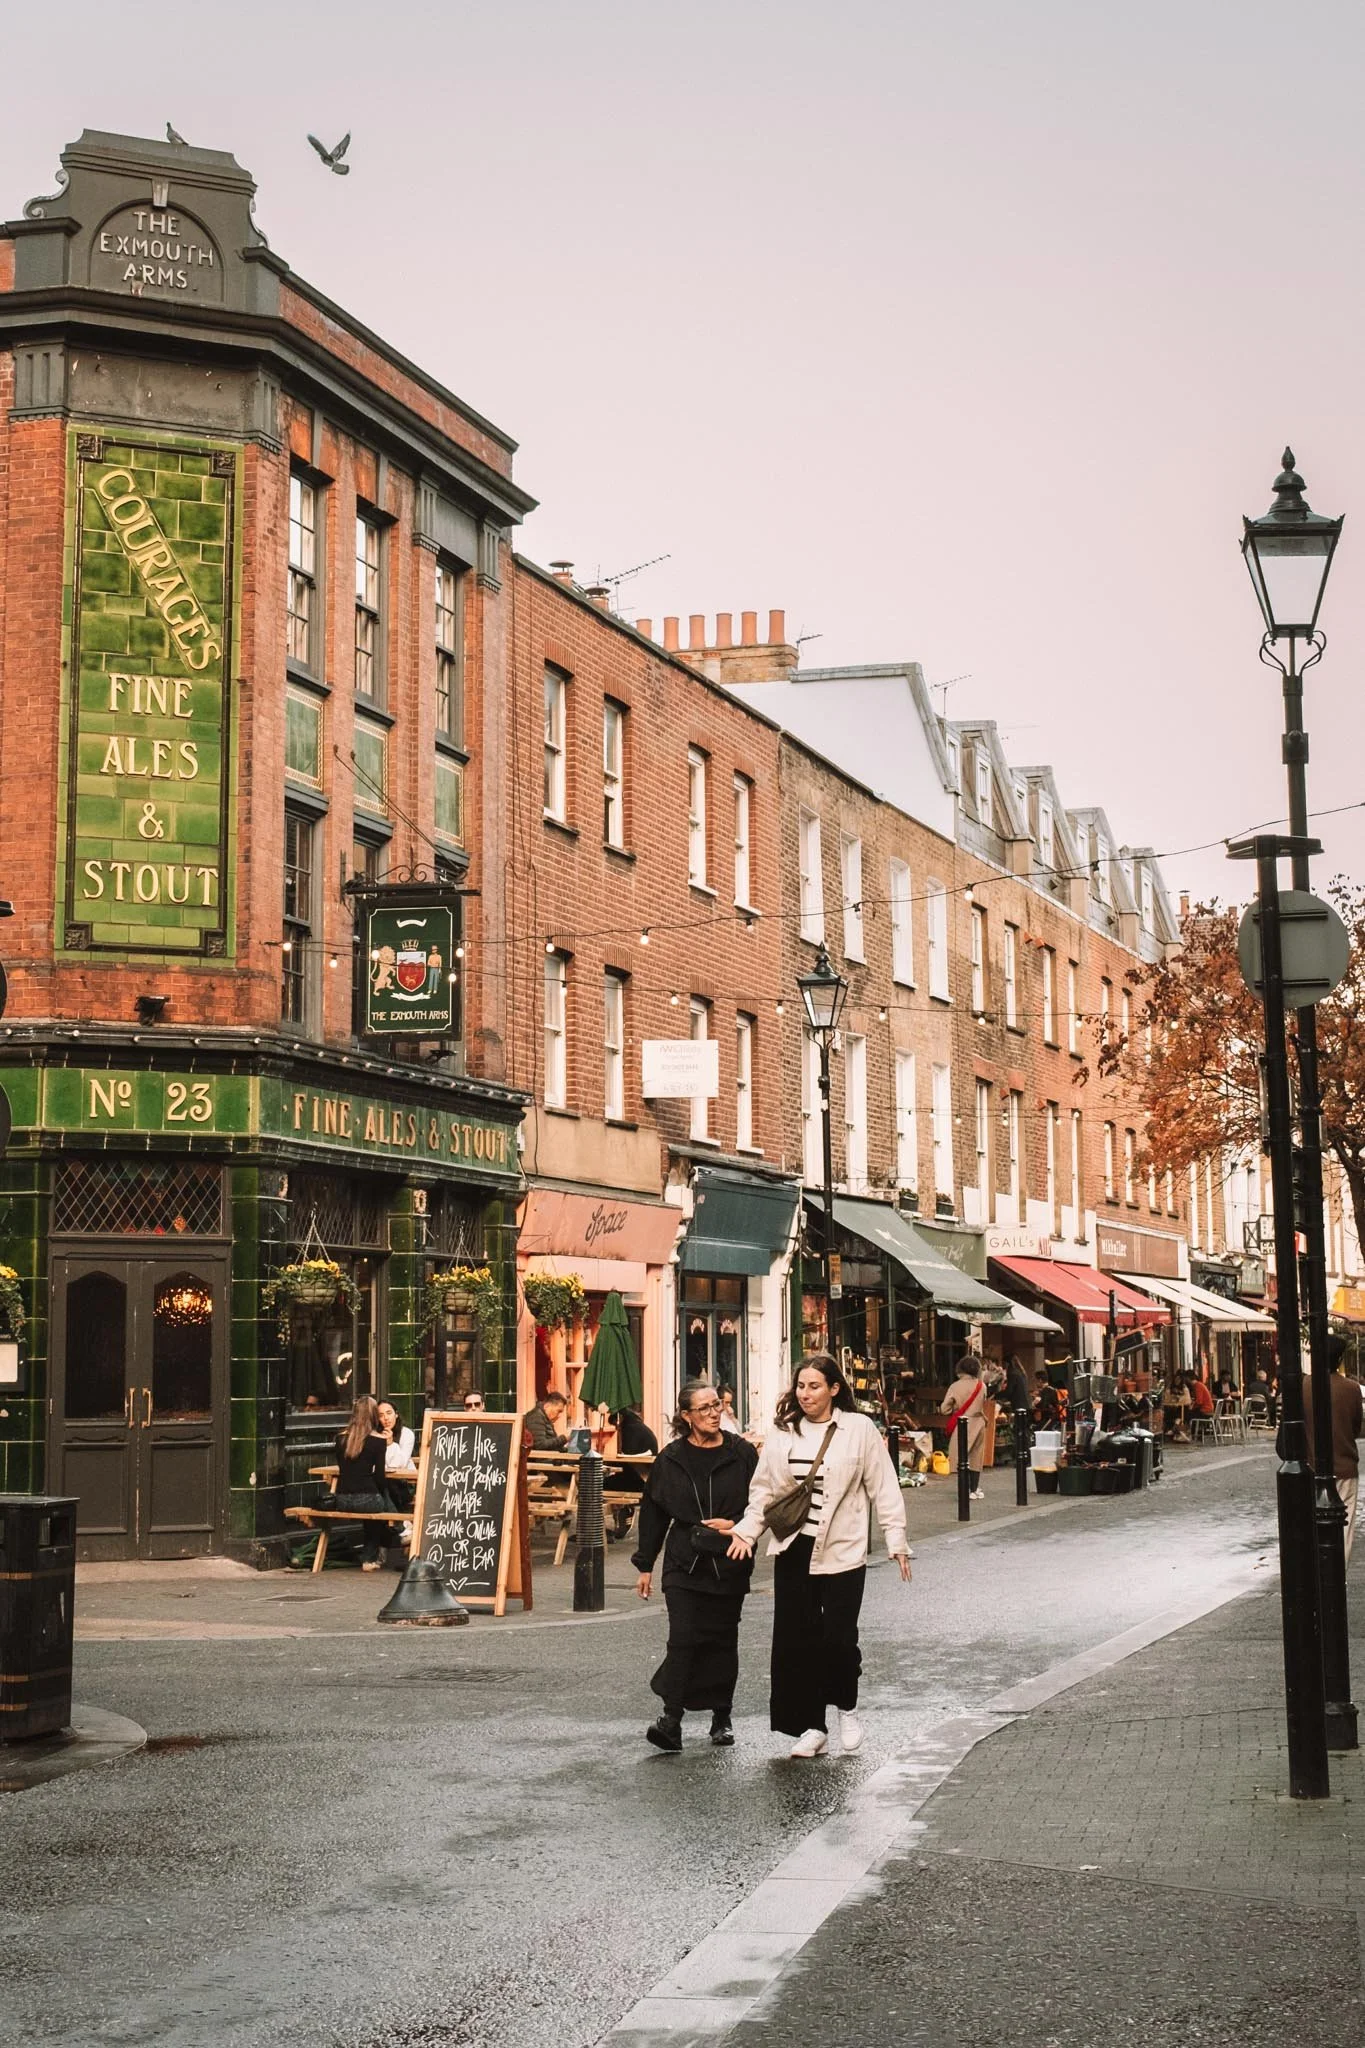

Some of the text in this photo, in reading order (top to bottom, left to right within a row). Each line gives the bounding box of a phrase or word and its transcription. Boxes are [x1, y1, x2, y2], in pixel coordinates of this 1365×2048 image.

[133, 211, 181, 236] THE
[100, 232, 214, 267] EXMOUTH
[122, 262, 188, 289] ARMS
[99, 469, 222, 670] COURAGES
[108, 673, 194, 718] FINE
[100, 736, 199, 779] ALES
[138, 801, 164, 839] &
[83, 860, 219, 906] STOUT
[371, 1010, 449, 1021] THE EXMOUTH ARMS
[167, 1082, 212, 1122] 23
[293, 1093, 508, 1164] FINE ALES & STOUT
[433, 1425, 498, 1466] PRIVATE HIRE
[441, 1465, 472, 1495] GROUP
[471, 1464, 507, 1493] BOOKINGS
[425, 1519, 497, 1541] ENQUIRE ONLINE
[453, 1539, 469, 1555] OR
[444, 1553, 470, 1572] THE
[473, 1546, 495, 1571] BAR
